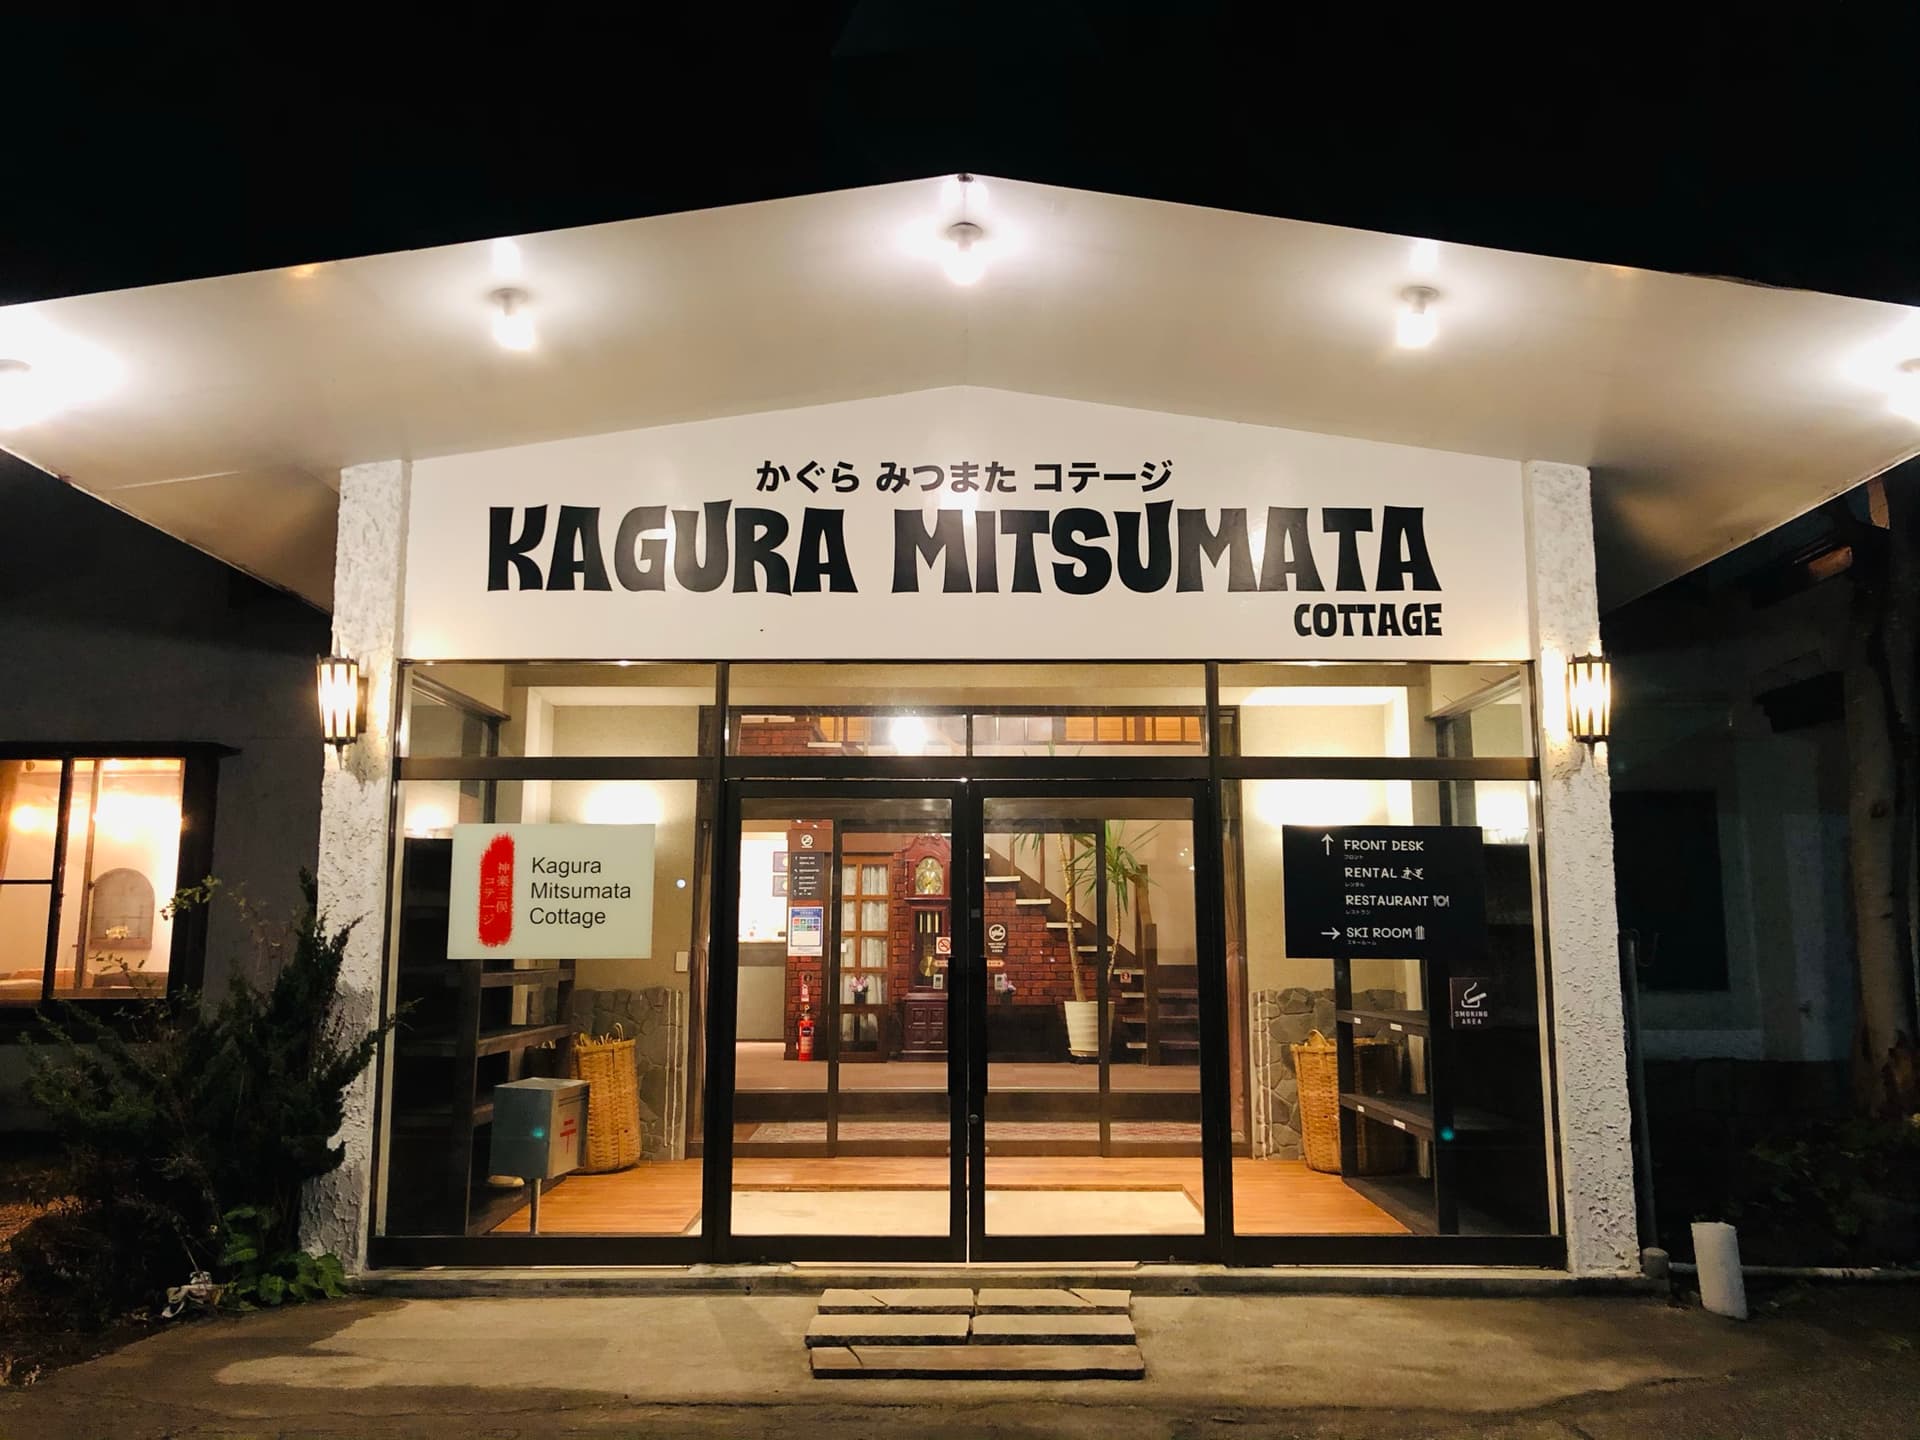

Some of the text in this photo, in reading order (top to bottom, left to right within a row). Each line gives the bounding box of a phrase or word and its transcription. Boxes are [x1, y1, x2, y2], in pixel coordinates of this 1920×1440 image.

[756, 460, 1174, 493] かぐら みつまた コテージ
[487, 499, 1443, 597] KAGURA MITSUMATA
[1293, 602, 1443, 638] COTTAGE
[1344, 839, 1425, 852] FRONT DESK
[531, 857, 602, 878] Kagura
[1344, 867, 1398, 879] RENTAL
[530, 882, 631, 899] Mitsumata
[1345, 895, 1429, 907] RESTAURANT
[482, 877, 496, 926] コテージ
[529, 907, 607, 929] Cottage
[1346, 927, 1413, 940] SKI ROOM
